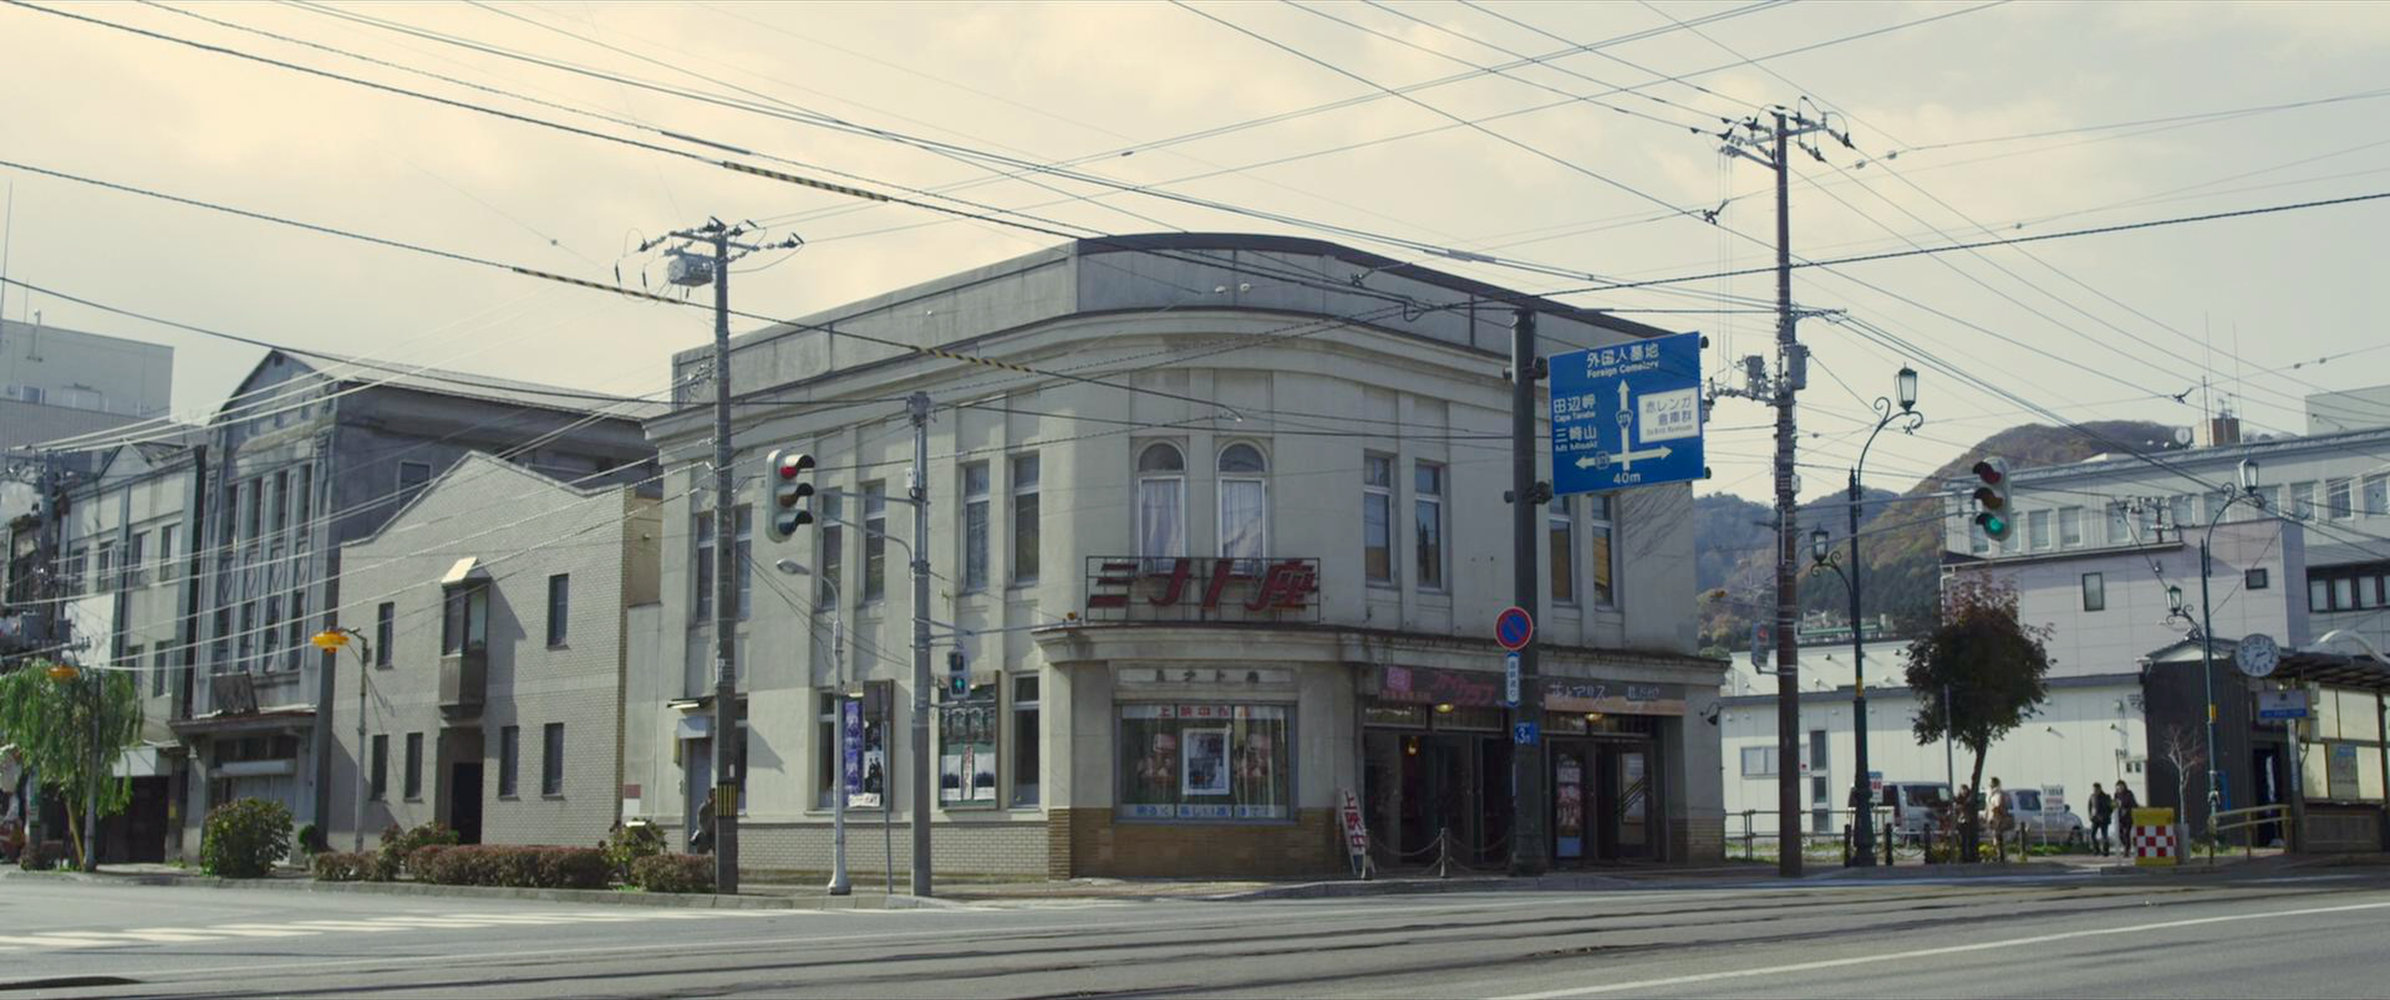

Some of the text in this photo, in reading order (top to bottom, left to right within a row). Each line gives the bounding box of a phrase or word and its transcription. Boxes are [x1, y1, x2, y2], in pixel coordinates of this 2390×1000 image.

[1587, 343, 1659, 368] 外国人墓地
[1587, 364, 1618, 379] Foreign
[1613, 472, 1641, 484] 40m
